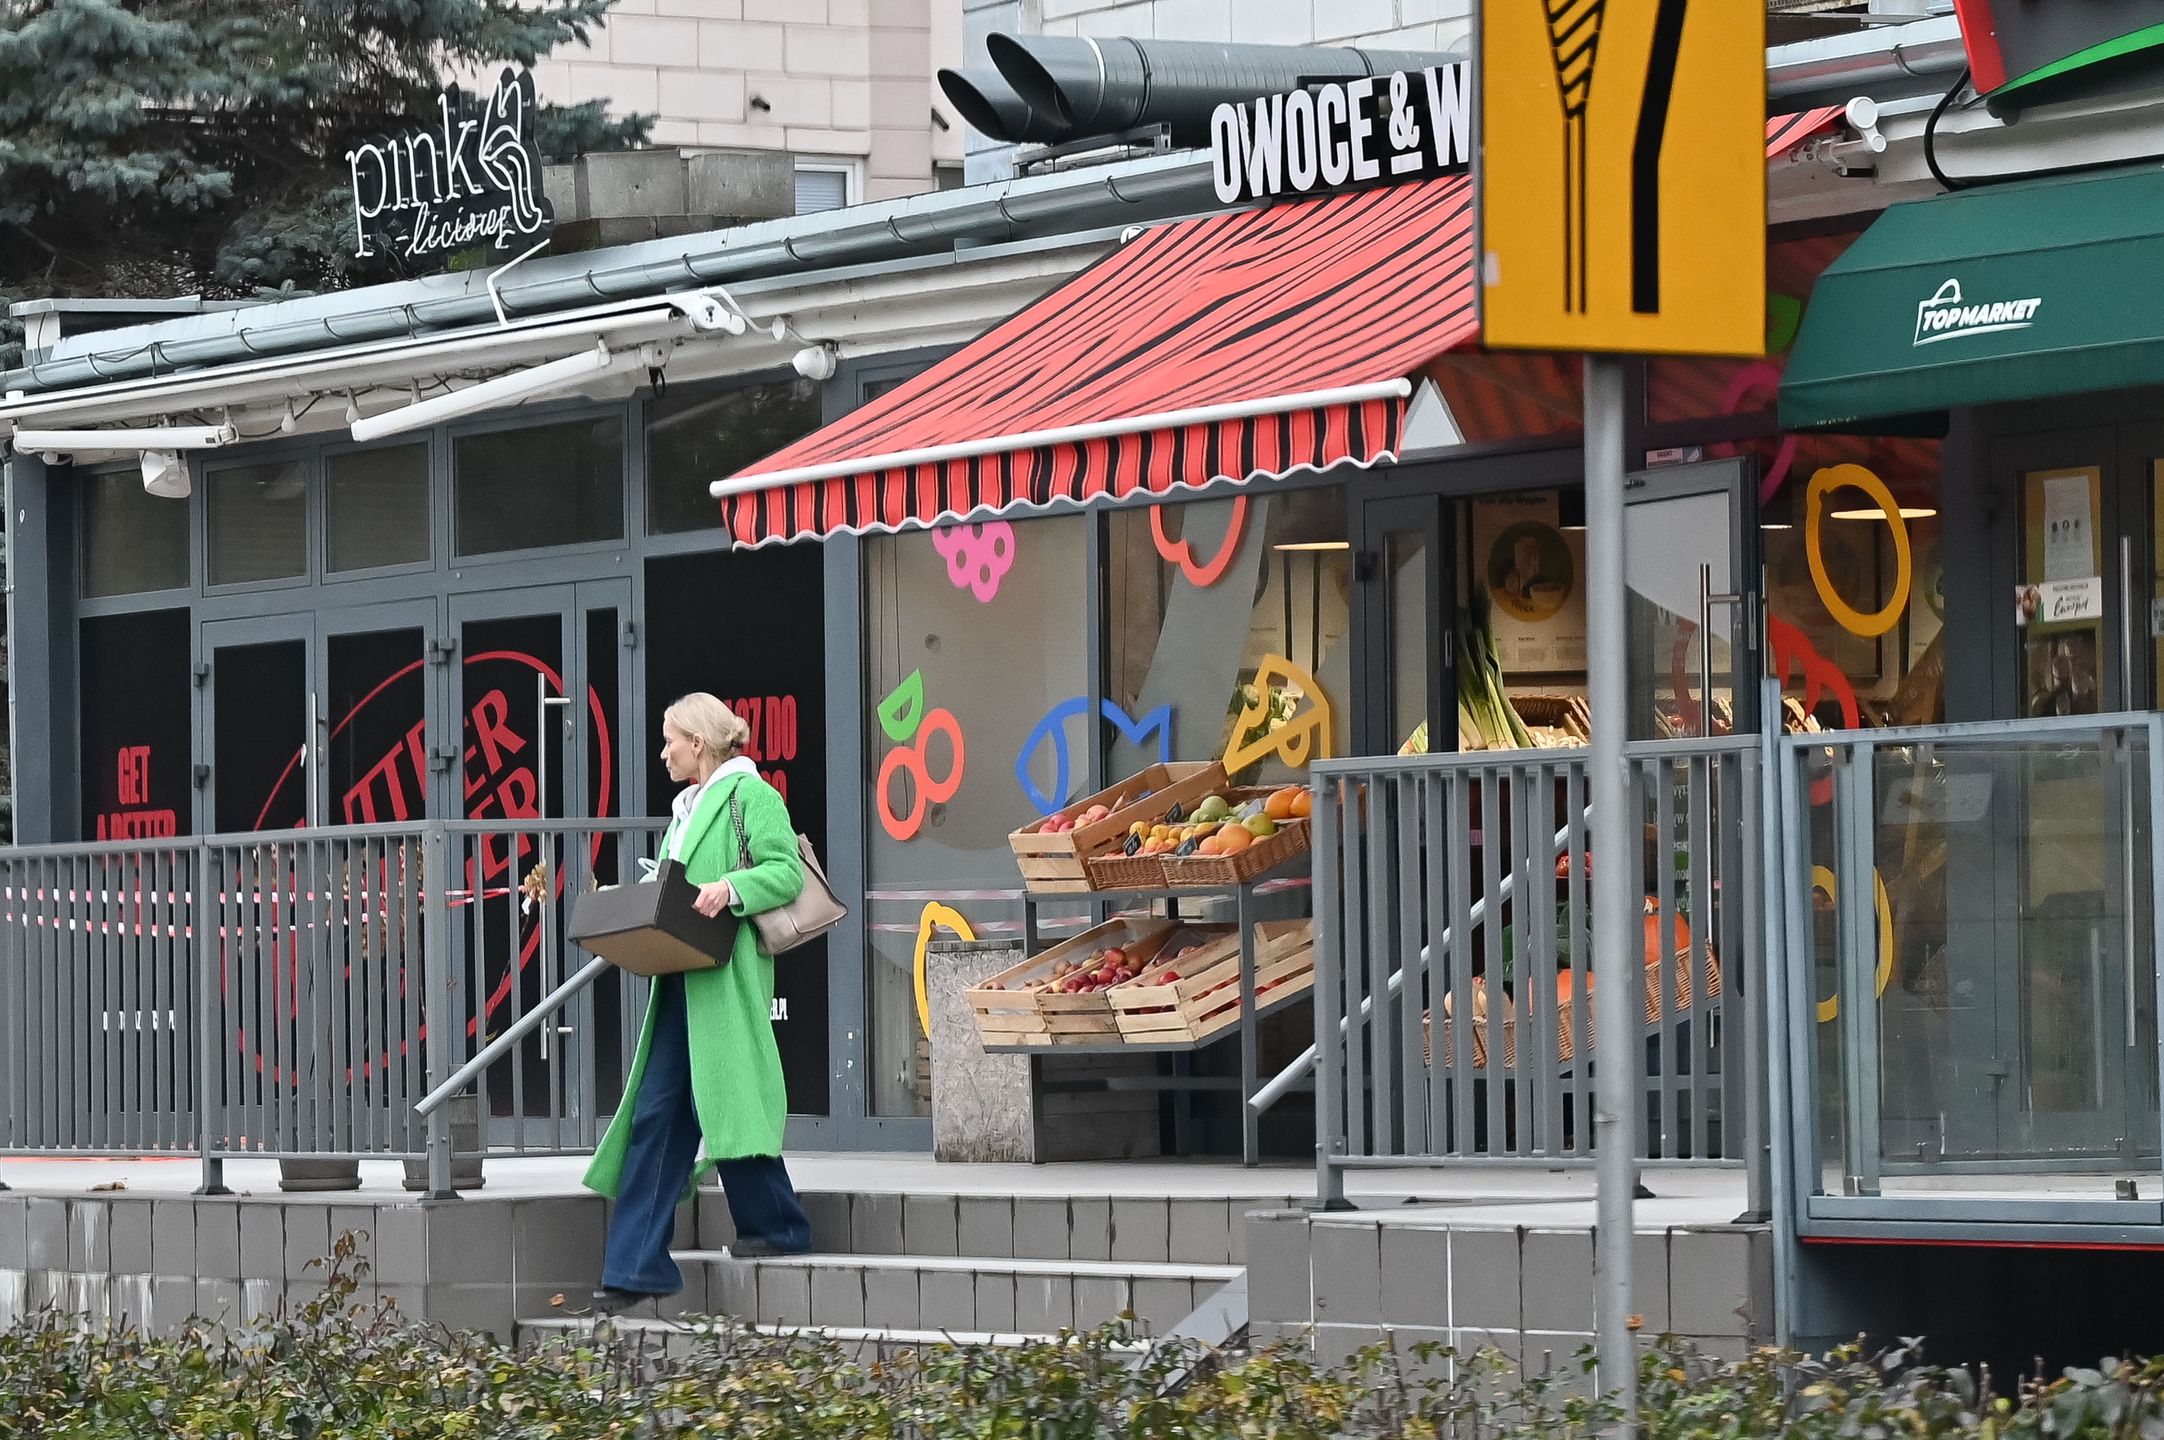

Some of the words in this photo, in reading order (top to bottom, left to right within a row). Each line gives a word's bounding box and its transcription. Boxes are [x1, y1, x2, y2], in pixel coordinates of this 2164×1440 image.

[1210, 77, 1380, 204] OWOCE
[1388, 70, 1421, 151] &
[1424, 60, 1472, 166] W
[1922, 298, 2042, 332] TOPMARKET
[117, 745, 150, 805] GET
